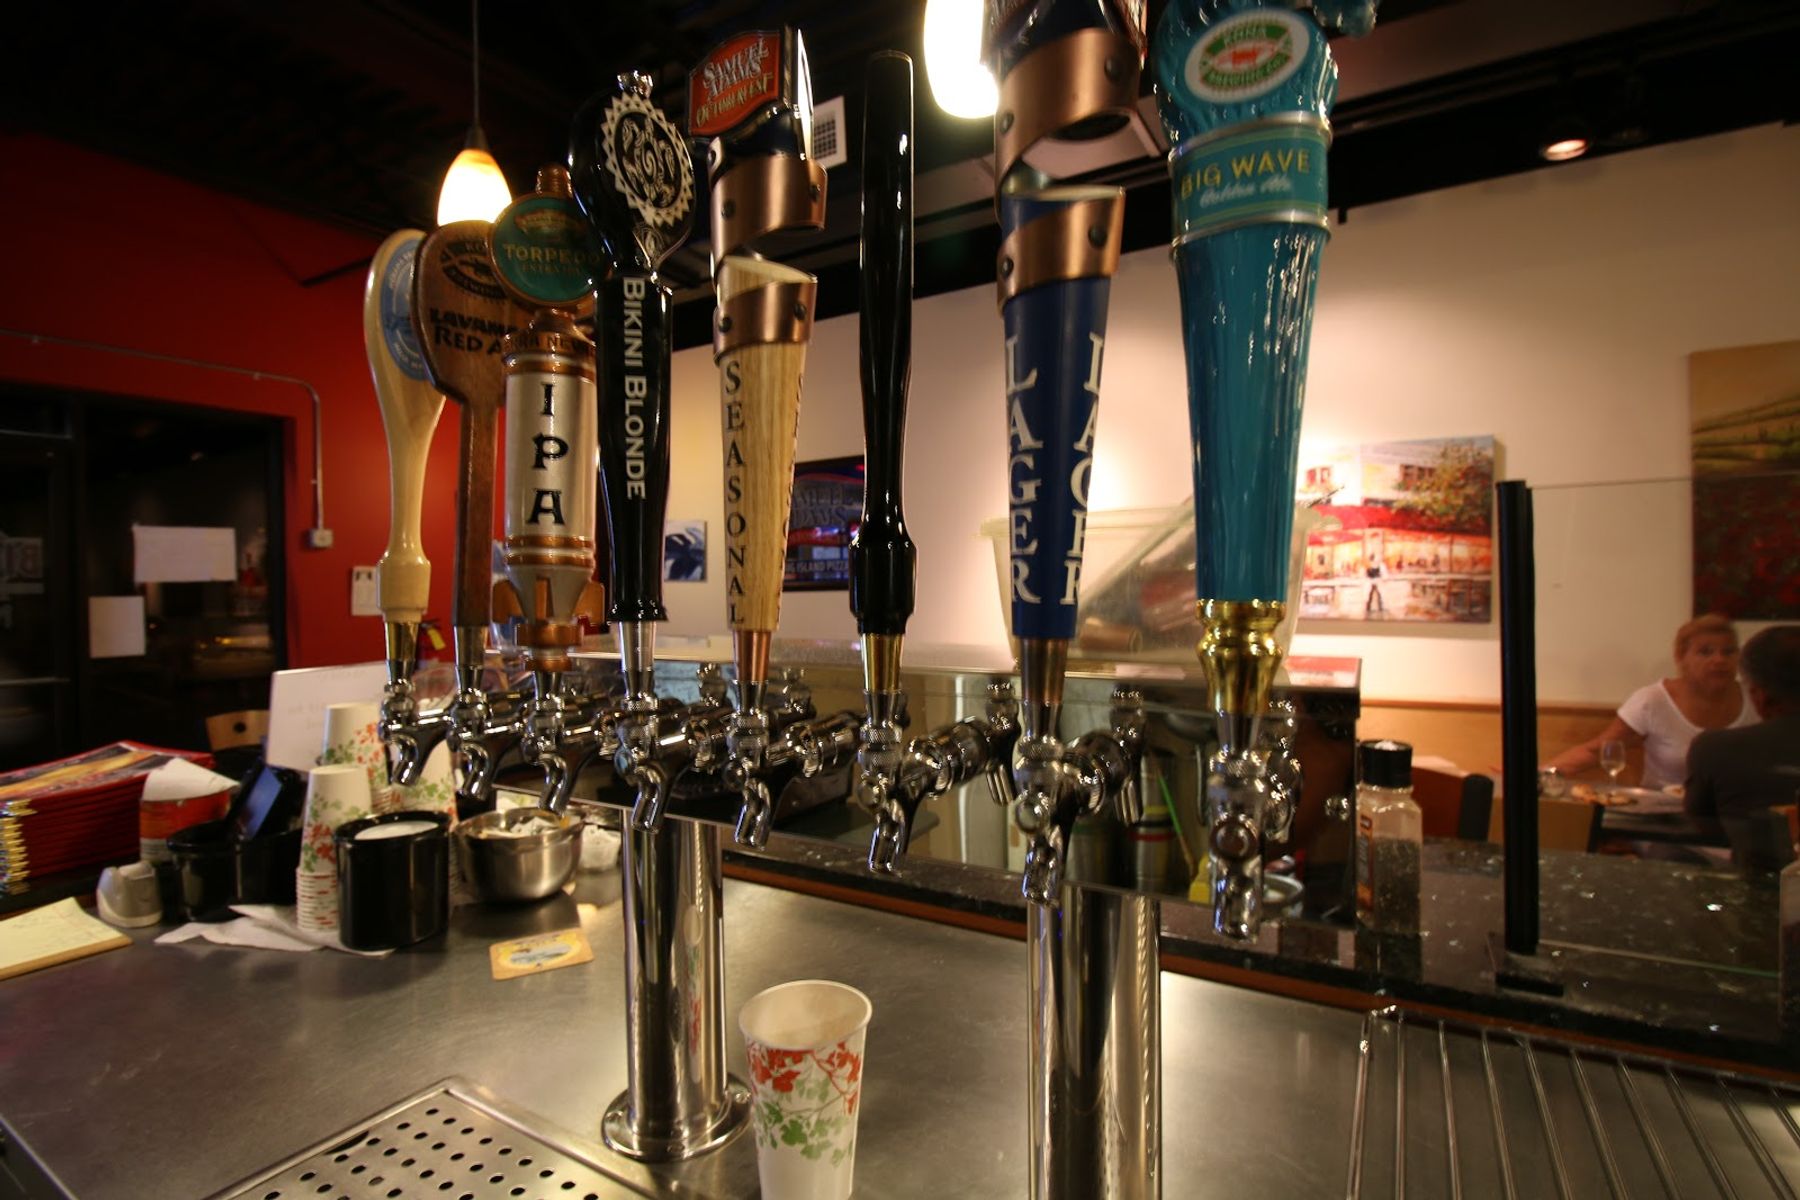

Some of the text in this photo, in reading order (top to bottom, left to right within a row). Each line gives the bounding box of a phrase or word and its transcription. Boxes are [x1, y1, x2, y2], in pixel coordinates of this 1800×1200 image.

[1180, 148, 1311, 200] BIG WAVE
[435, 326, 483, 352] RED
[622, 277, 648, 500] BIKINI BLONDE
[526, 383, 569, 526] IPA
[725, 359, 747, 625] SEASONAL
[1006, 334, 1044, 603] LAGER
